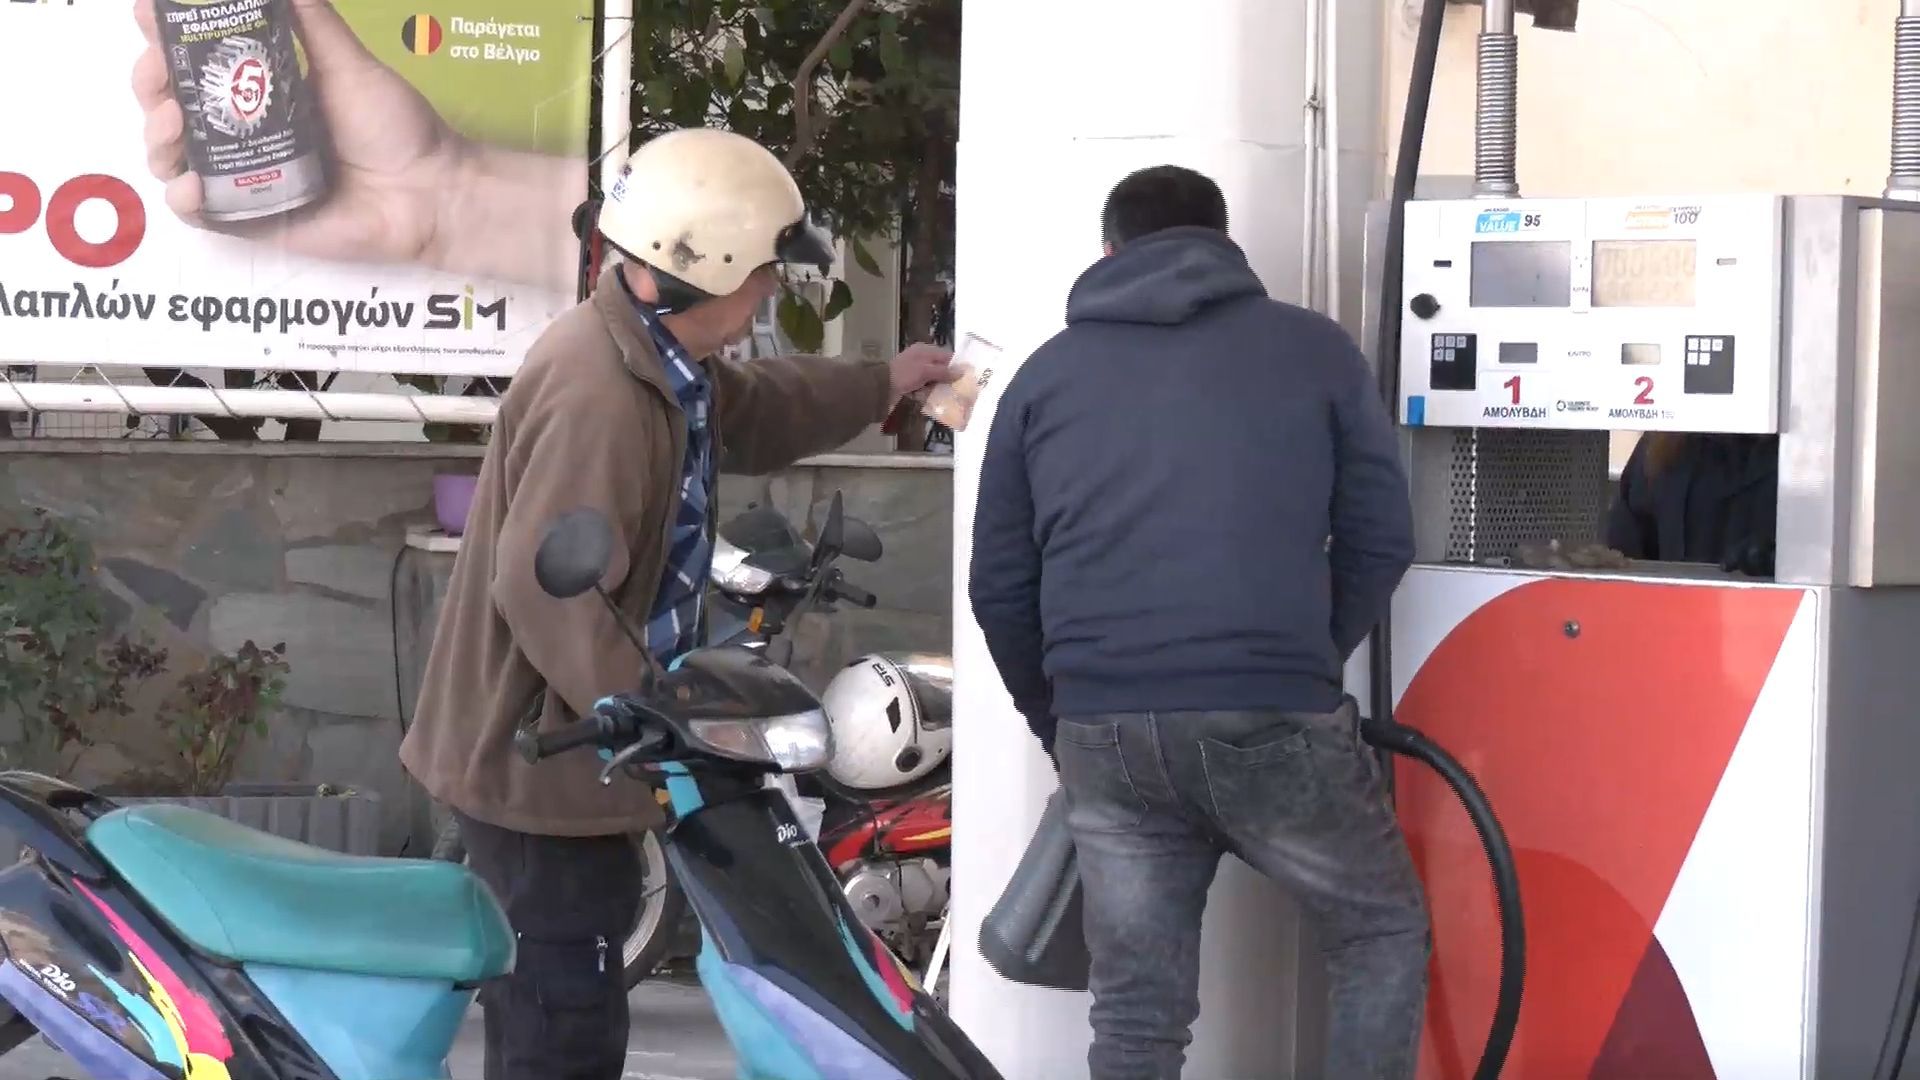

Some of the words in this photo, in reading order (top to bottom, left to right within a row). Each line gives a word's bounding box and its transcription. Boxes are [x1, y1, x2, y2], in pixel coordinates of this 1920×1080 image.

[182, 9, 264, 34] ΕΦΑΡΜΟΓΩΝ
[451, 16, 541, 38] Παράγεται
[451, 45, 479, 59] στο
[484, 43, 541, 65] Βέλγιο
[1524, 214, 1542, 228] 95
[168, 286, 414, 335] εφαρμογών
[1503, 375, 1521, 405] 1
[1633, 375, 1655, 405] 2
[1482, 406, 1547, 418] ΑΜΟΛΥΒΔΗ
[1608, 408, 1658, 420] ΑΜΟΛΥΒΔΗ
[776, 823, 798, 843] Dio
[41, 963, 76, 991] Dio
